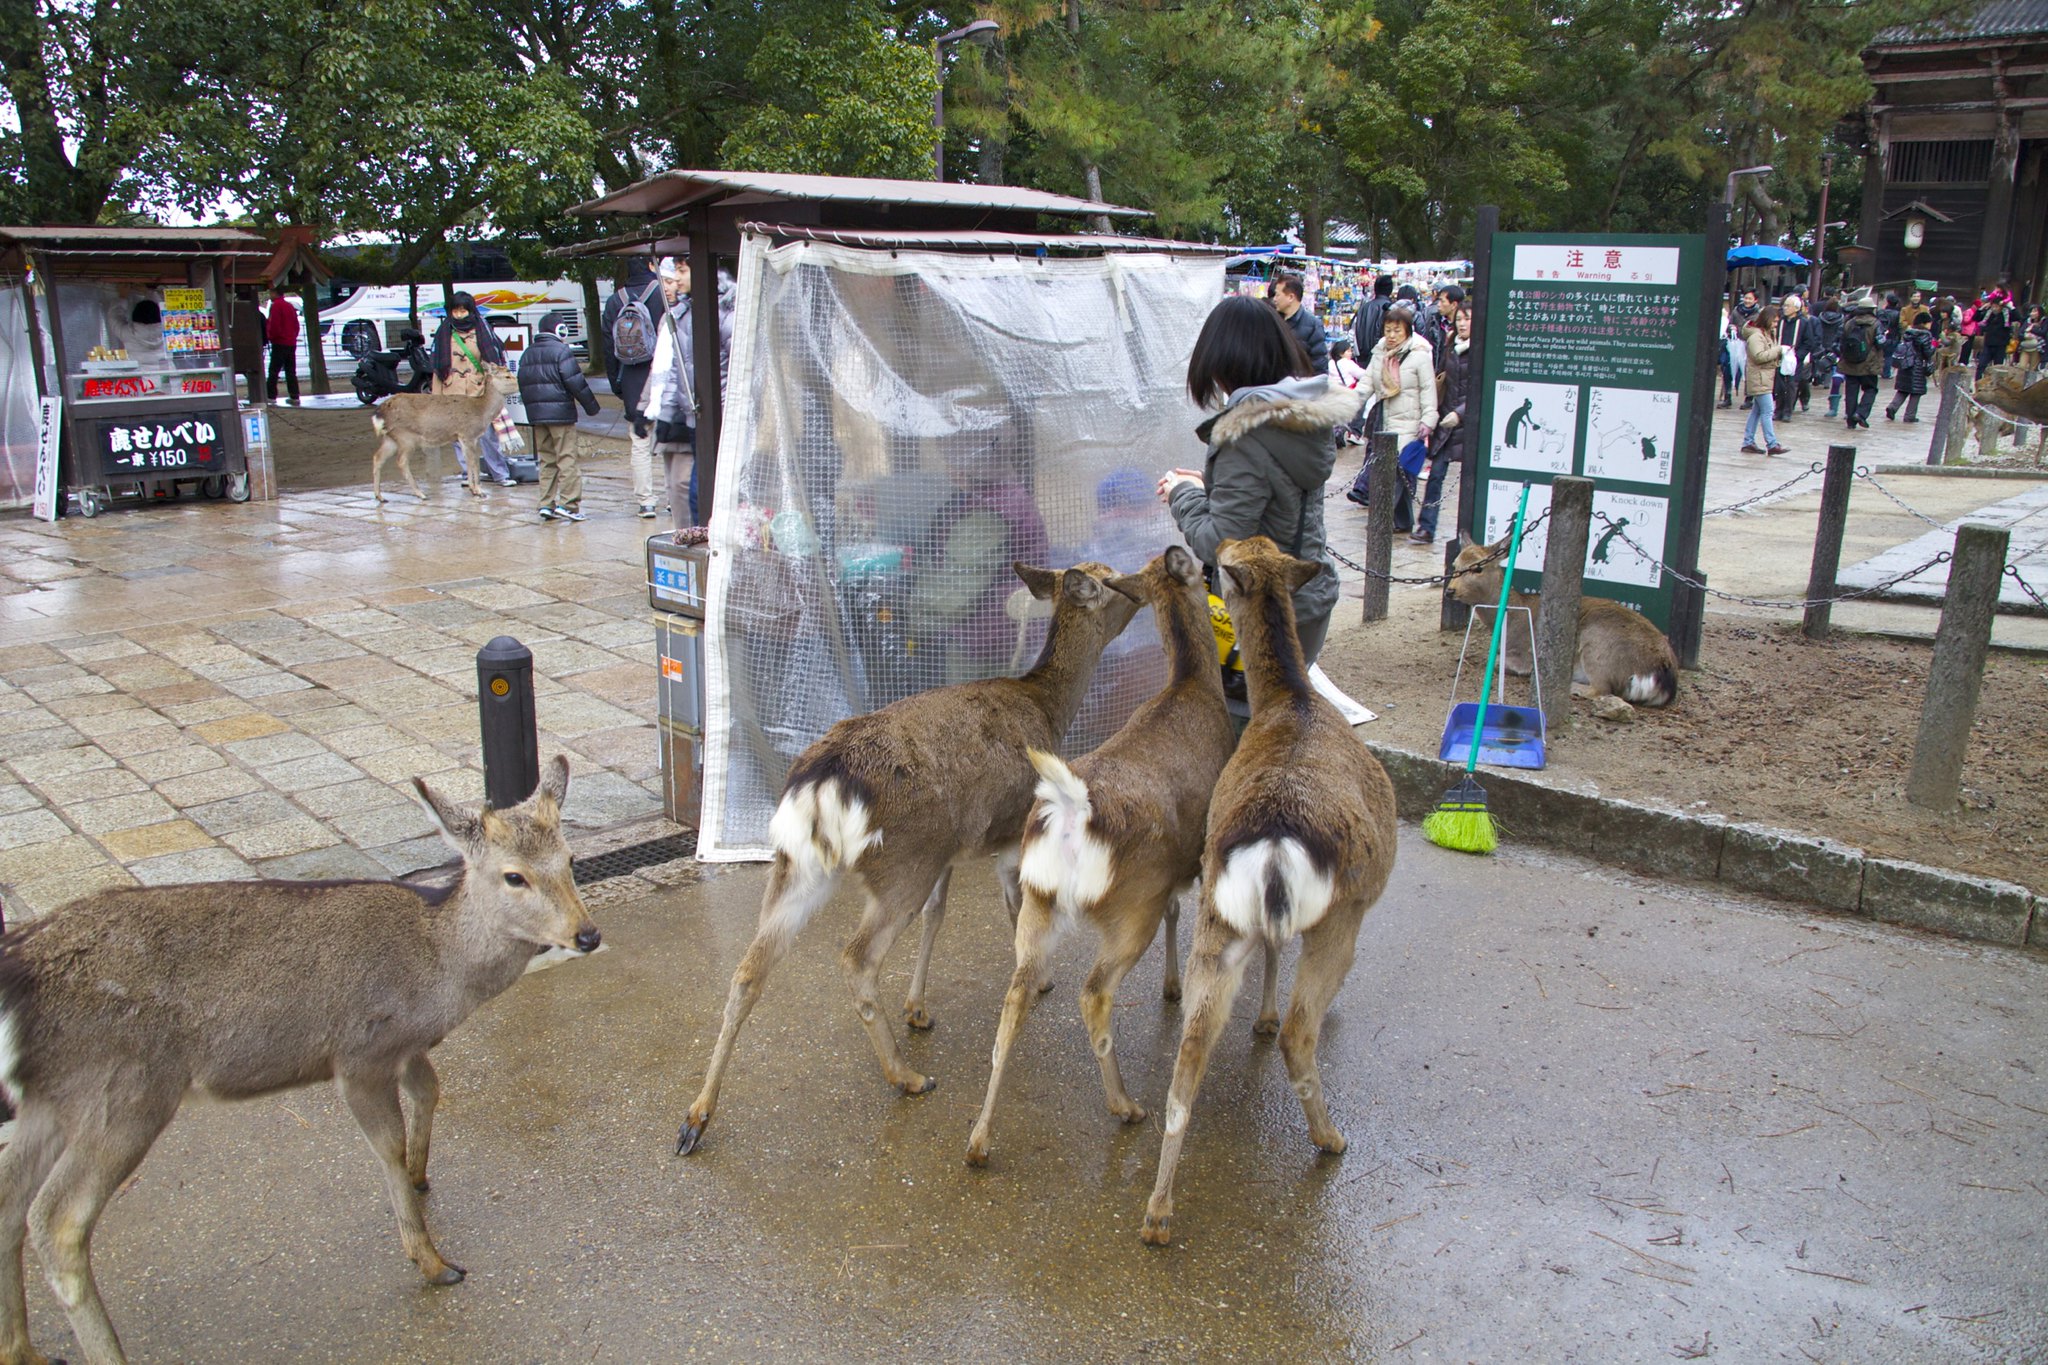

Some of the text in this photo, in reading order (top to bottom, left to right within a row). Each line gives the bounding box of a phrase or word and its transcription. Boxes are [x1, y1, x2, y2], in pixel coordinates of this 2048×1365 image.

[1566, 249, 1622, 269] 注意
[1577, 271, 1611, 281] Warning
[1613, 340, 1626, 348] They
[1639, 343, 1675, 351] occasionally
[1499, 384, 1515, 392] Bite
[1564, 388, 1577, 413] かむ
[1652, 394, 1672, 403] Kick
[1590, 389, 1603, 429] たたく
[109, 421, 216, 452] 鹿せんべい
[149, 448, 187, 467] ¥150
[1493, 483, 1508, 491] Butt
[1611, 495, 1663, 508] Knock down
